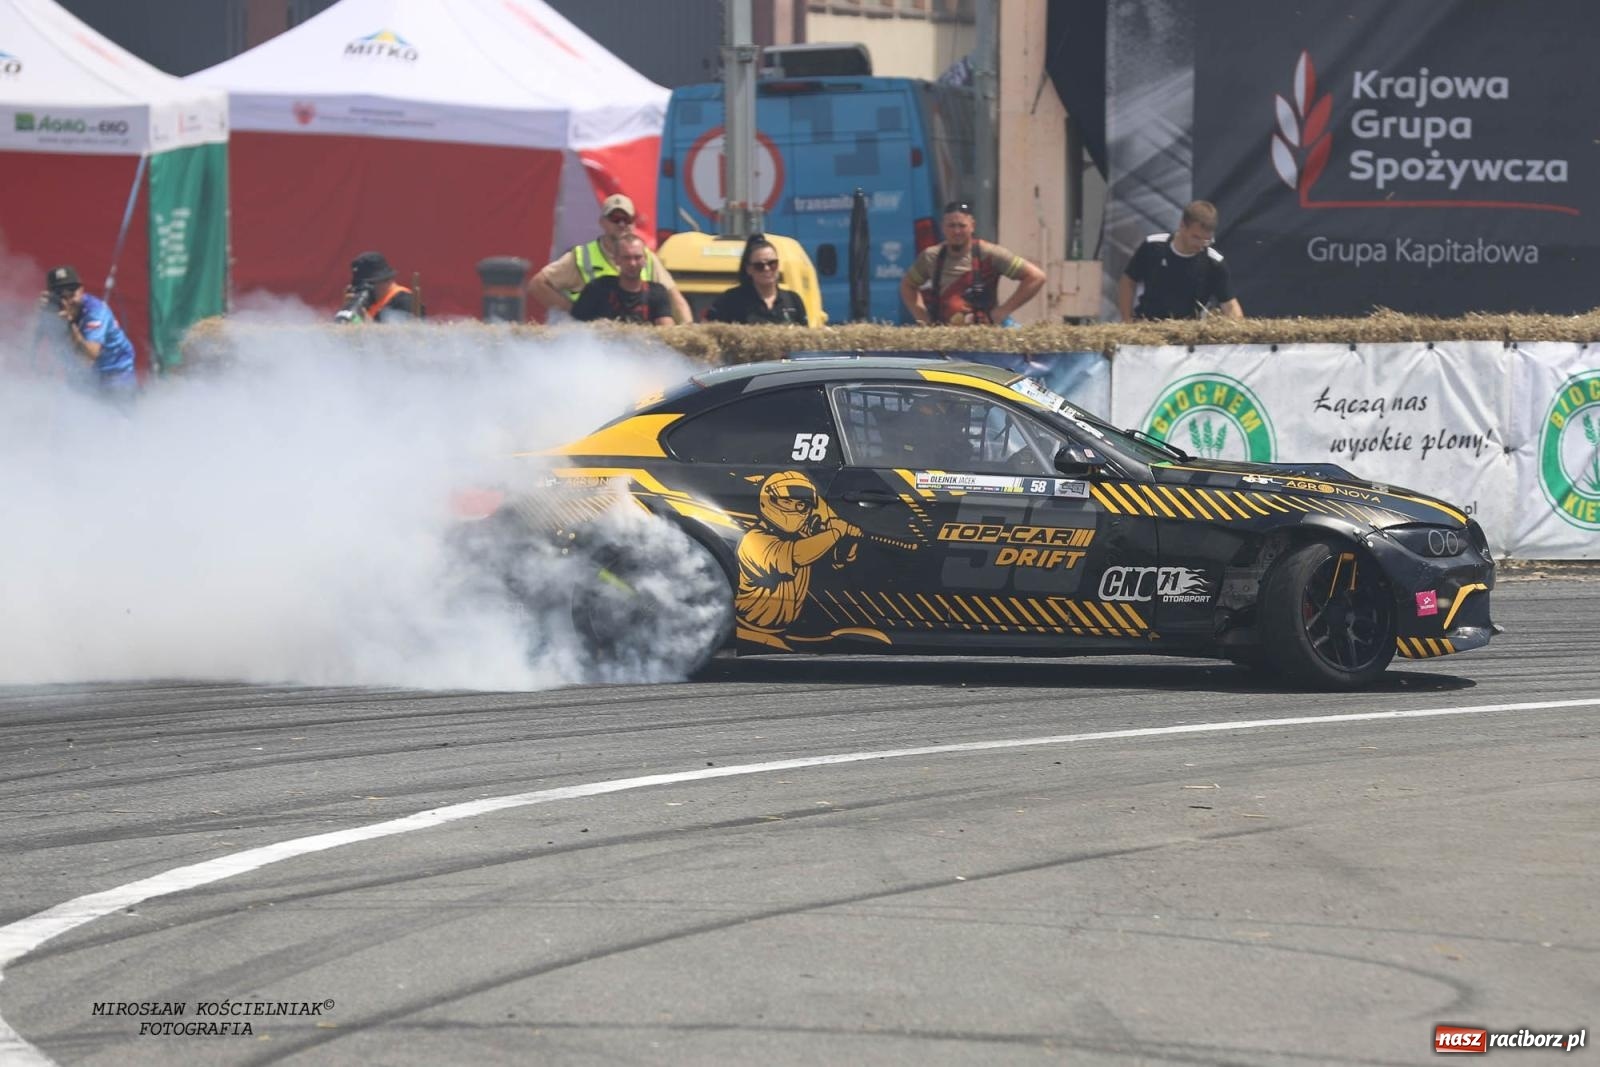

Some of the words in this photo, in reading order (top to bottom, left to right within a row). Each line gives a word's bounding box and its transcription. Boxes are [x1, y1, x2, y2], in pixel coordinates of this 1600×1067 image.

[1352, 67, 1509, 108] Krajowa
[1351, 109, 1472, 148] Grupa
[1349, 150, 1568, 190] Spożywcza
[1307, 237, 1387, 267] Grupa
[1396, 238, 1540, 268] Kapitałowa
[1151, 383, 1263, 435] BIOCHEM
[1313, 387, 1385, 419] Łączą
[1392, 395, 1428, 412] nas
[791, 433, 830, 461] 58
[1329, 427, 1413, 461] wysokie
[1420, 428, 1492, 460] plony!
[1030, 480, 1047, 493] 58
[940, 524, 1075, 546] TOP-CAR
[994, 548, 1086, 569] DRIFT
